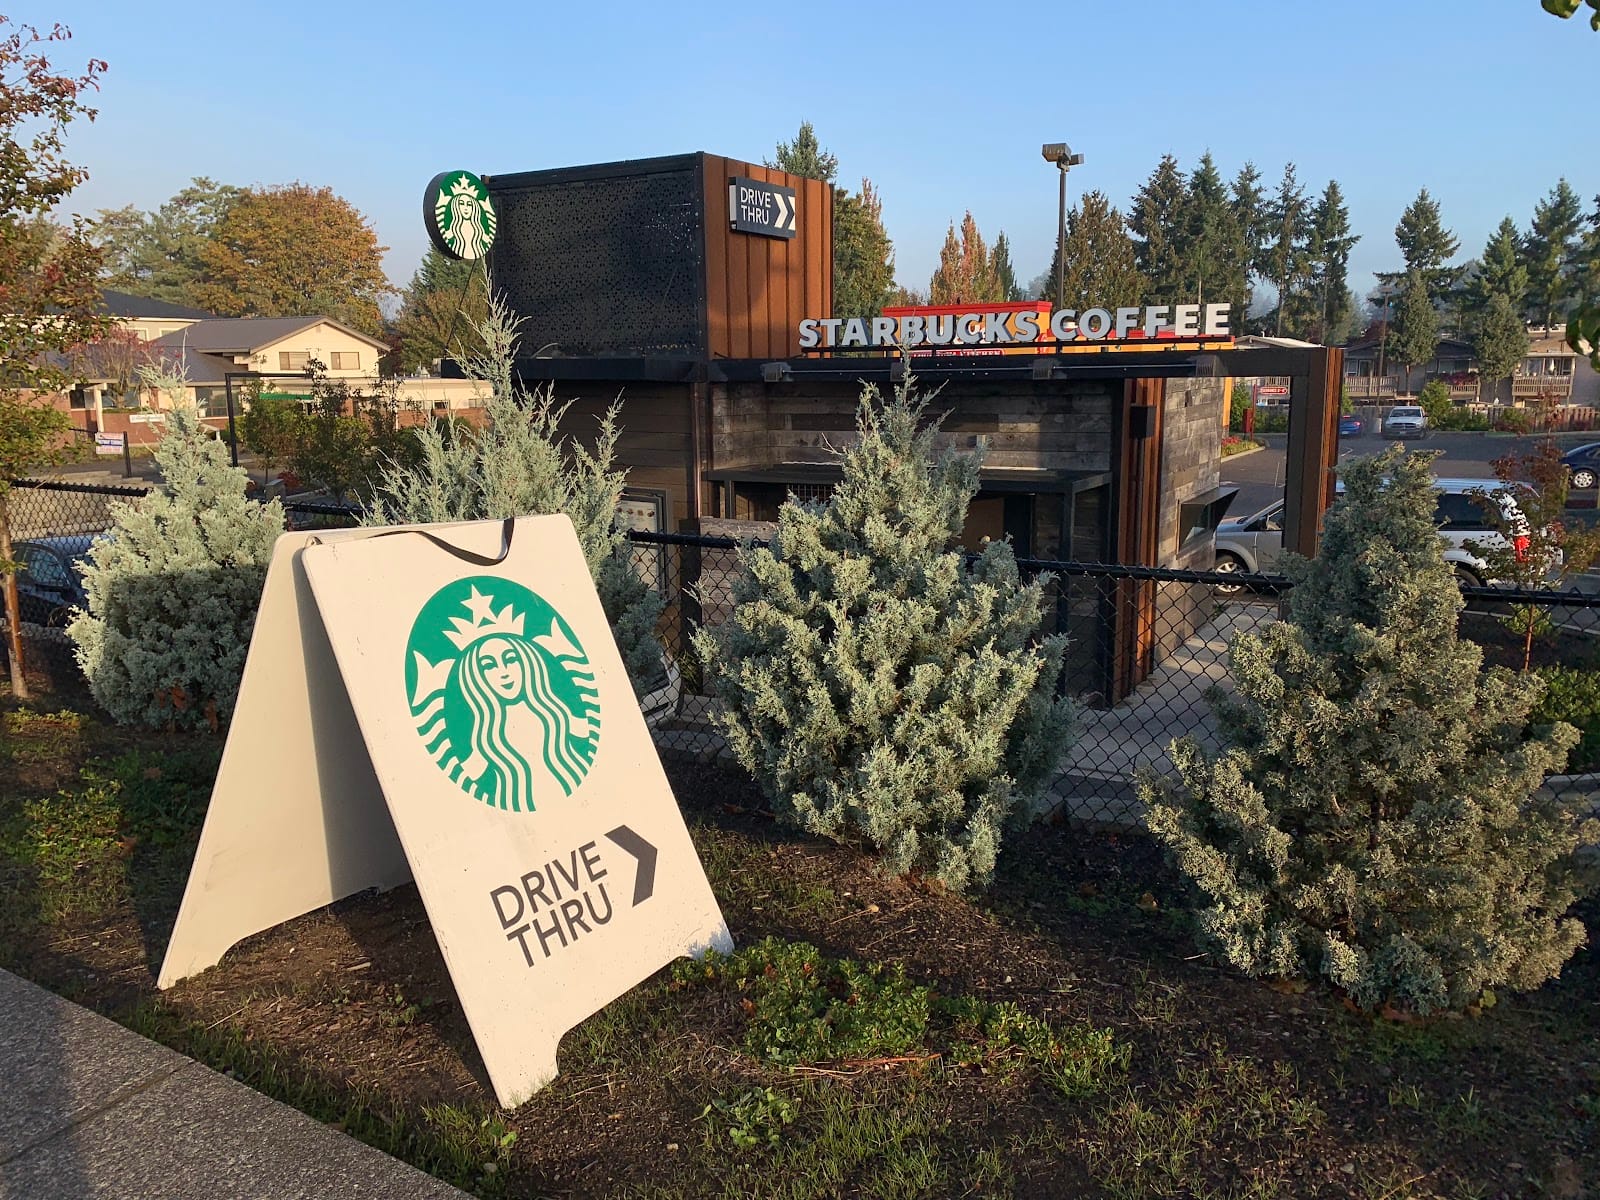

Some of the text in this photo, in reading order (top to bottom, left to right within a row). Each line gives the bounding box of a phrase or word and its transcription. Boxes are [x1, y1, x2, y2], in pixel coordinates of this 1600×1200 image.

[740, 186, 771, 208] DRIVE
[741, 205, 769, 225] THRU
[799, 303, 1231, 347] STARBUCKS COFFEE
[490, 840, 608, 930] DRIVE
[506, 882, 612, 968] THRU
